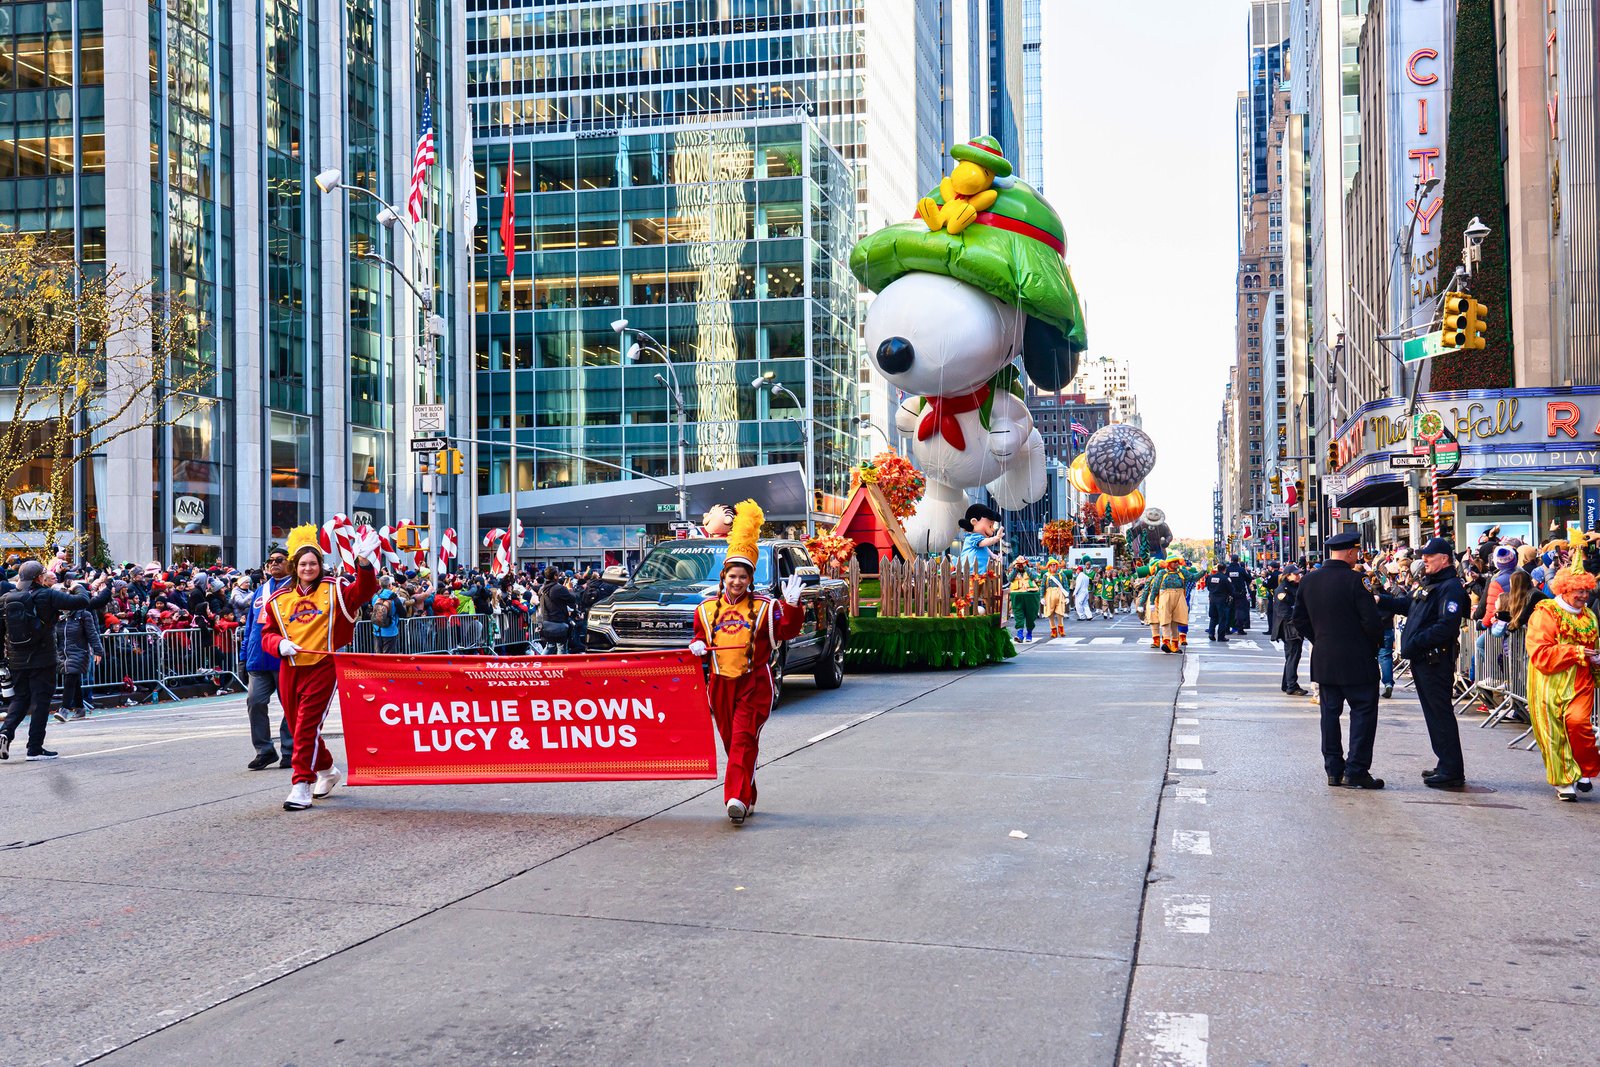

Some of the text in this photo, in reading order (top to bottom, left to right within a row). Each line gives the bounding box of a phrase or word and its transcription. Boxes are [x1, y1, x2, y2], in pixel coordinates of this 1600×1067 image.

[1405, 47, 1445, 235] CITY
[1409, 245, 1441, 280] MUSI
[1450, 397, 1523, 442] Hall
[1498, 450, 1598, 466] NOW PLAY
[14, 496, 53, 512] AVRA
[178, 499, 205, 516] AVRA
[1587, 505, 1596, 530] Avenu
[465, 670, 564, 679] THANKSGIVING DAY
[379, 698, 666, 726] CHARLIE BROWN,
[413, 724, 638, 752] LUCY & LINUS
